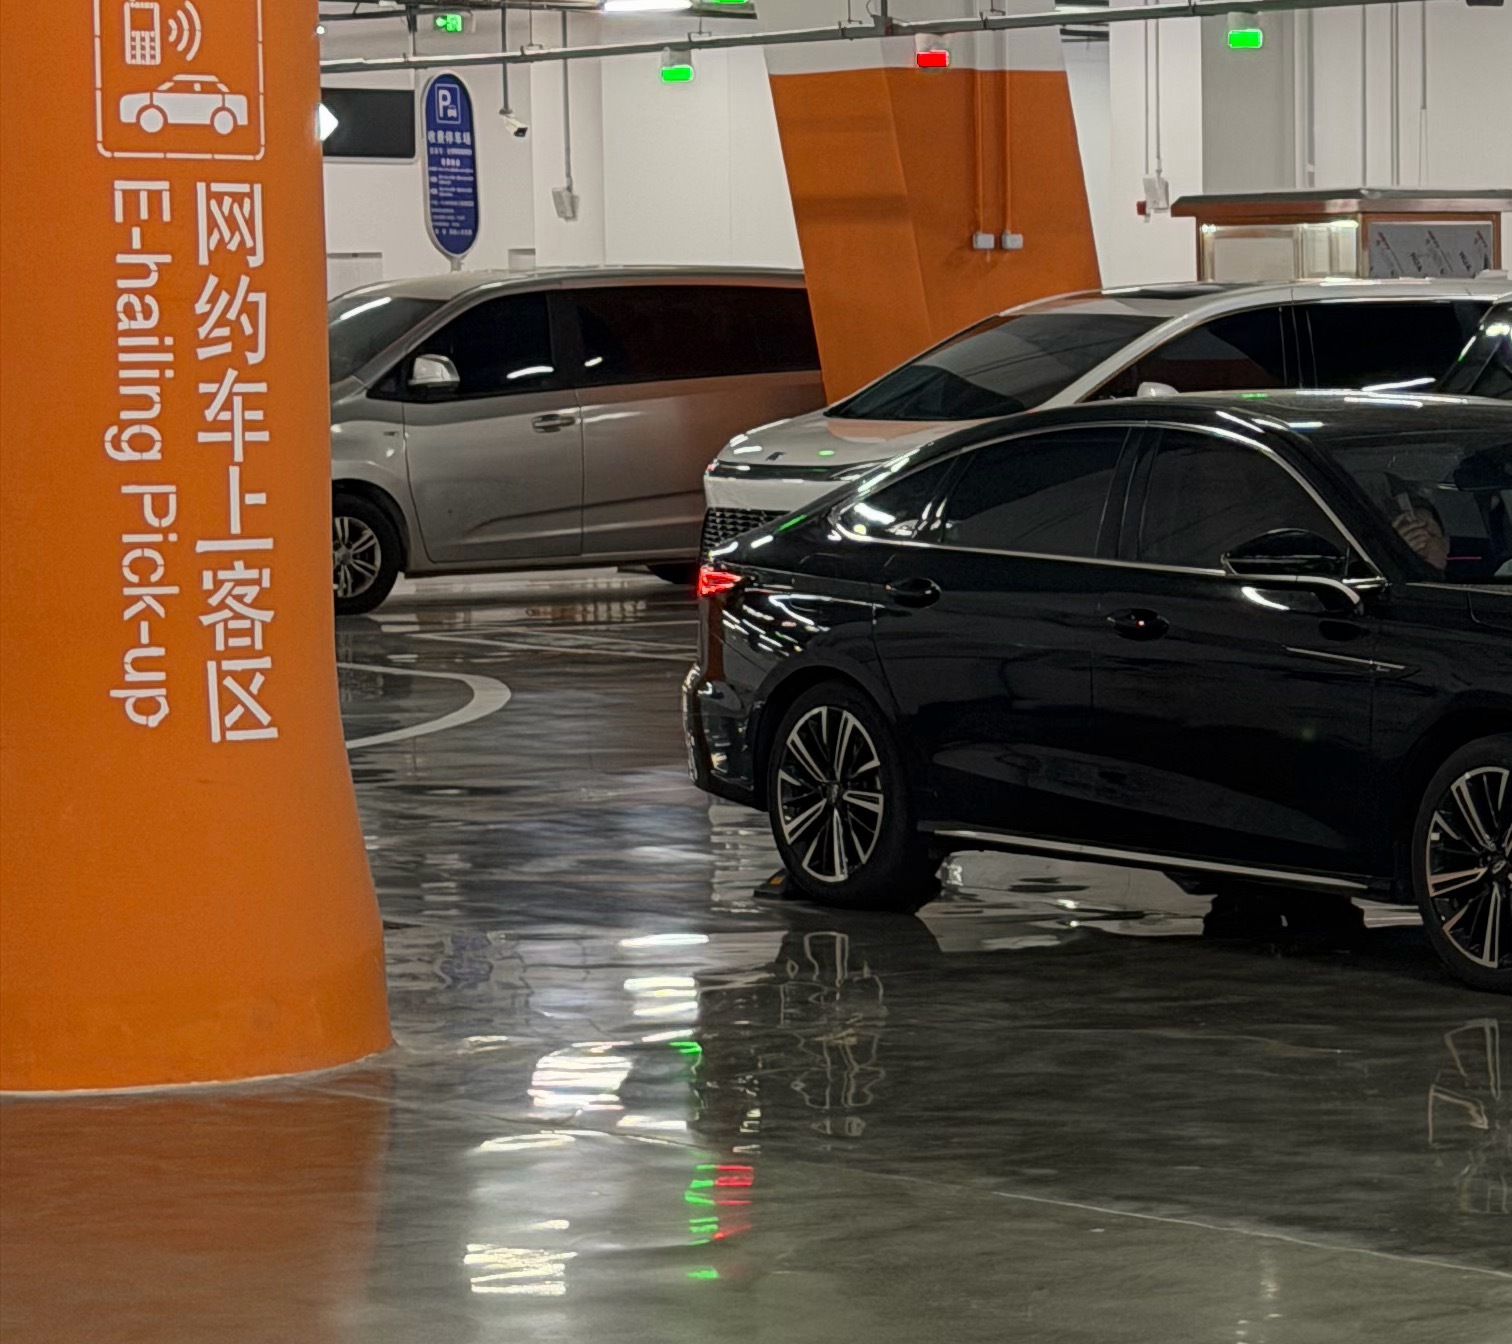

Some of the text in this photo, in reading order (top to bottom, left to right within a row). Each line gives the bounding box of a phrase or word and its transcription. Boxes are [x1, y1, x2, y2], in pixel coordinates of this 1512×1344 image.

[103, 179, 179, 729] E-hailing Pick-up
[194, 180, 279, 744] 网约车上客区
